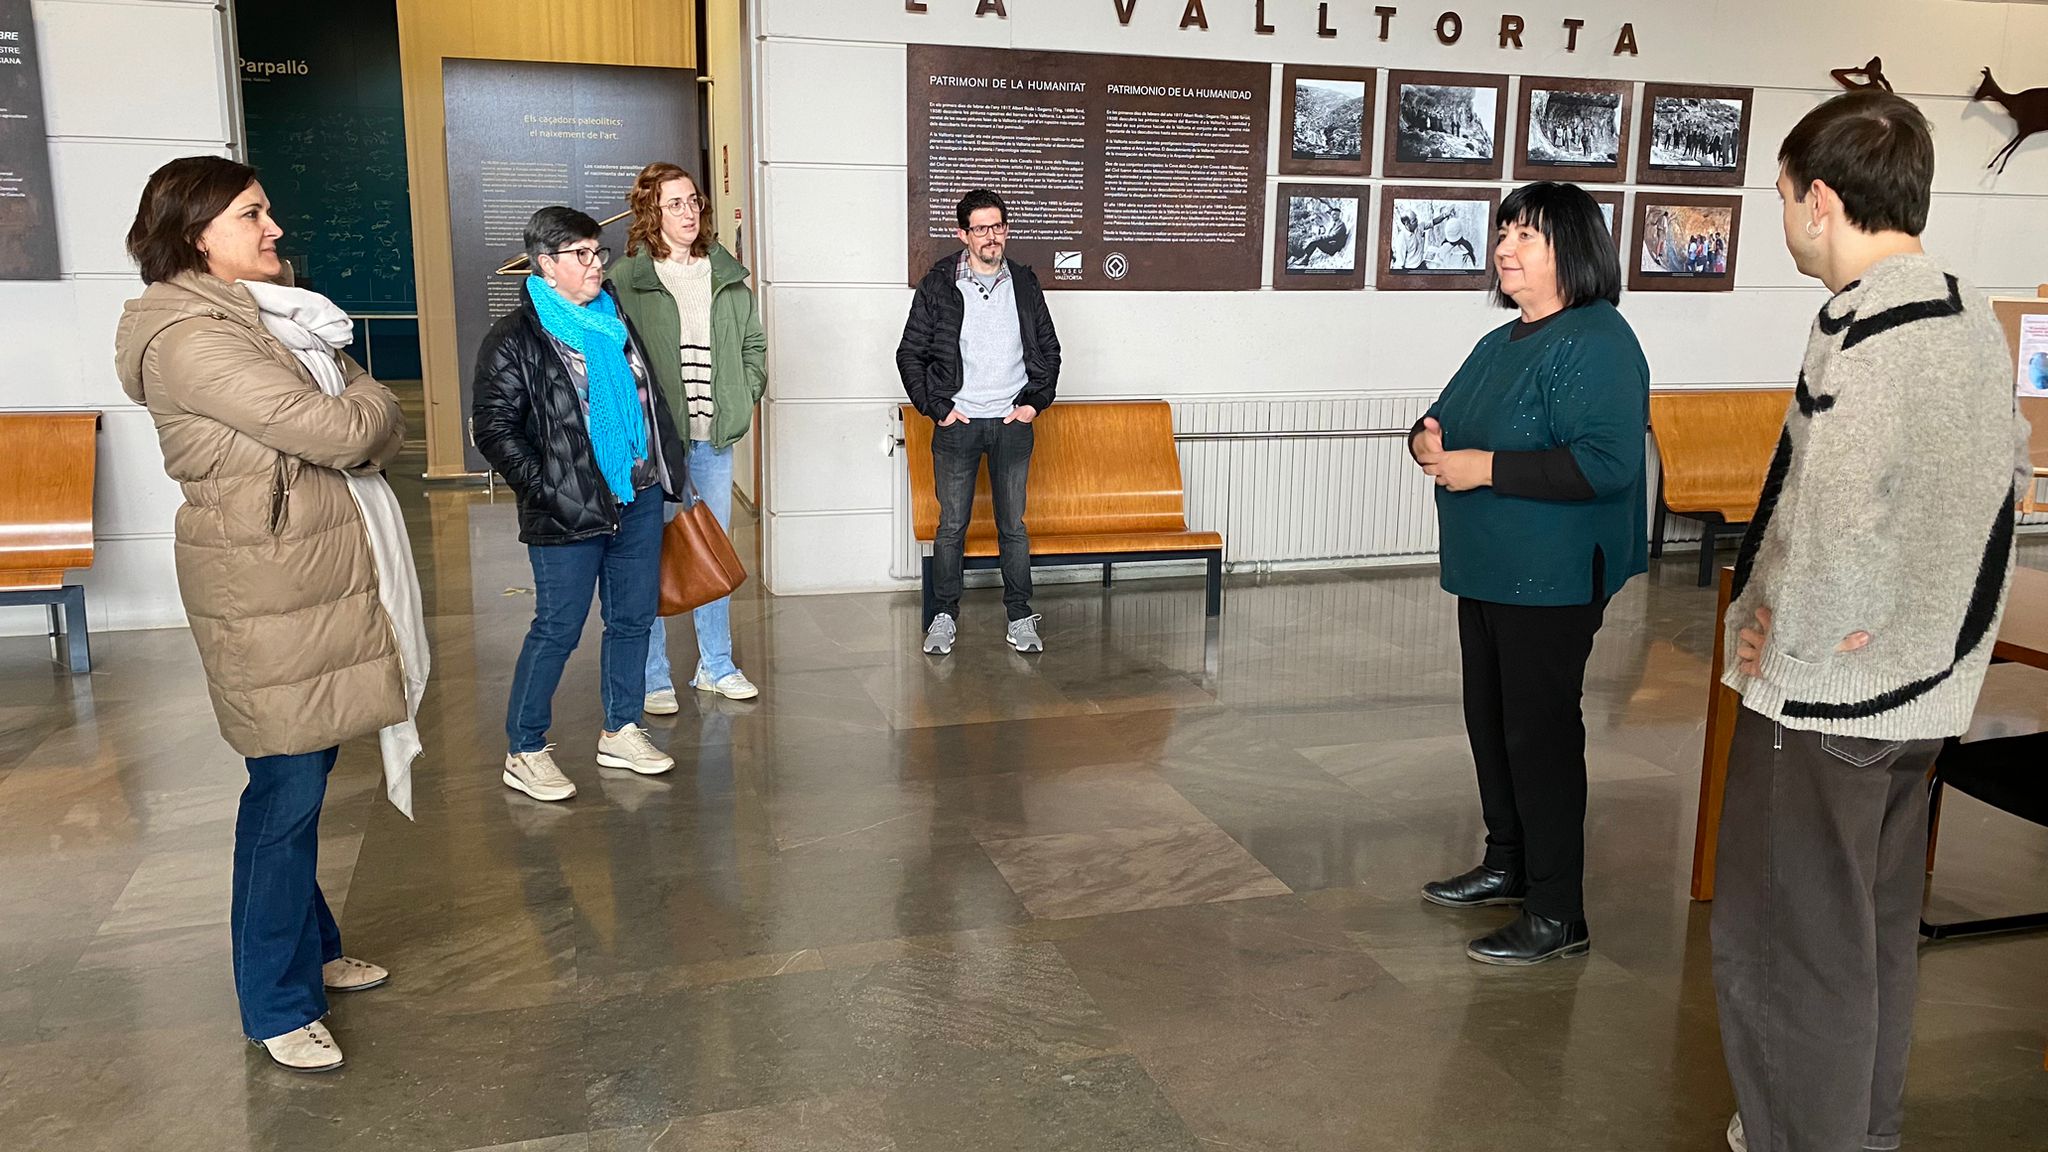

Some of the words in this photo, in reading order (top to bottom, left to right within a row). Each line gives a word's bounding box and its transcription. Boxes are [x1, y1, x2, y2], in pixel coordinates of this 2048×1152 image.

[1114, 0, 1639, 55] VALLTORTA
[0, 56, 21, 65] IANA
[239, 58, 309, 76] Parpalló
[929, 75, 988, 88] PATRIMONI
[992, 78, 1006, 89] DE
[1011, 79, 1024, 90] LA
[1028, 80, 1086, 92] HUMANITAT
[1107, 84, 1166, 96] PATRIMONIO
[1168, 87, 1181, 97] DE
[1183, 88, 1194, 97] LA
[1196, 88, 1252, 100] HUMANIDAD
[524, 114, 537, 123] Els
[587, 131, 598, 139] de
